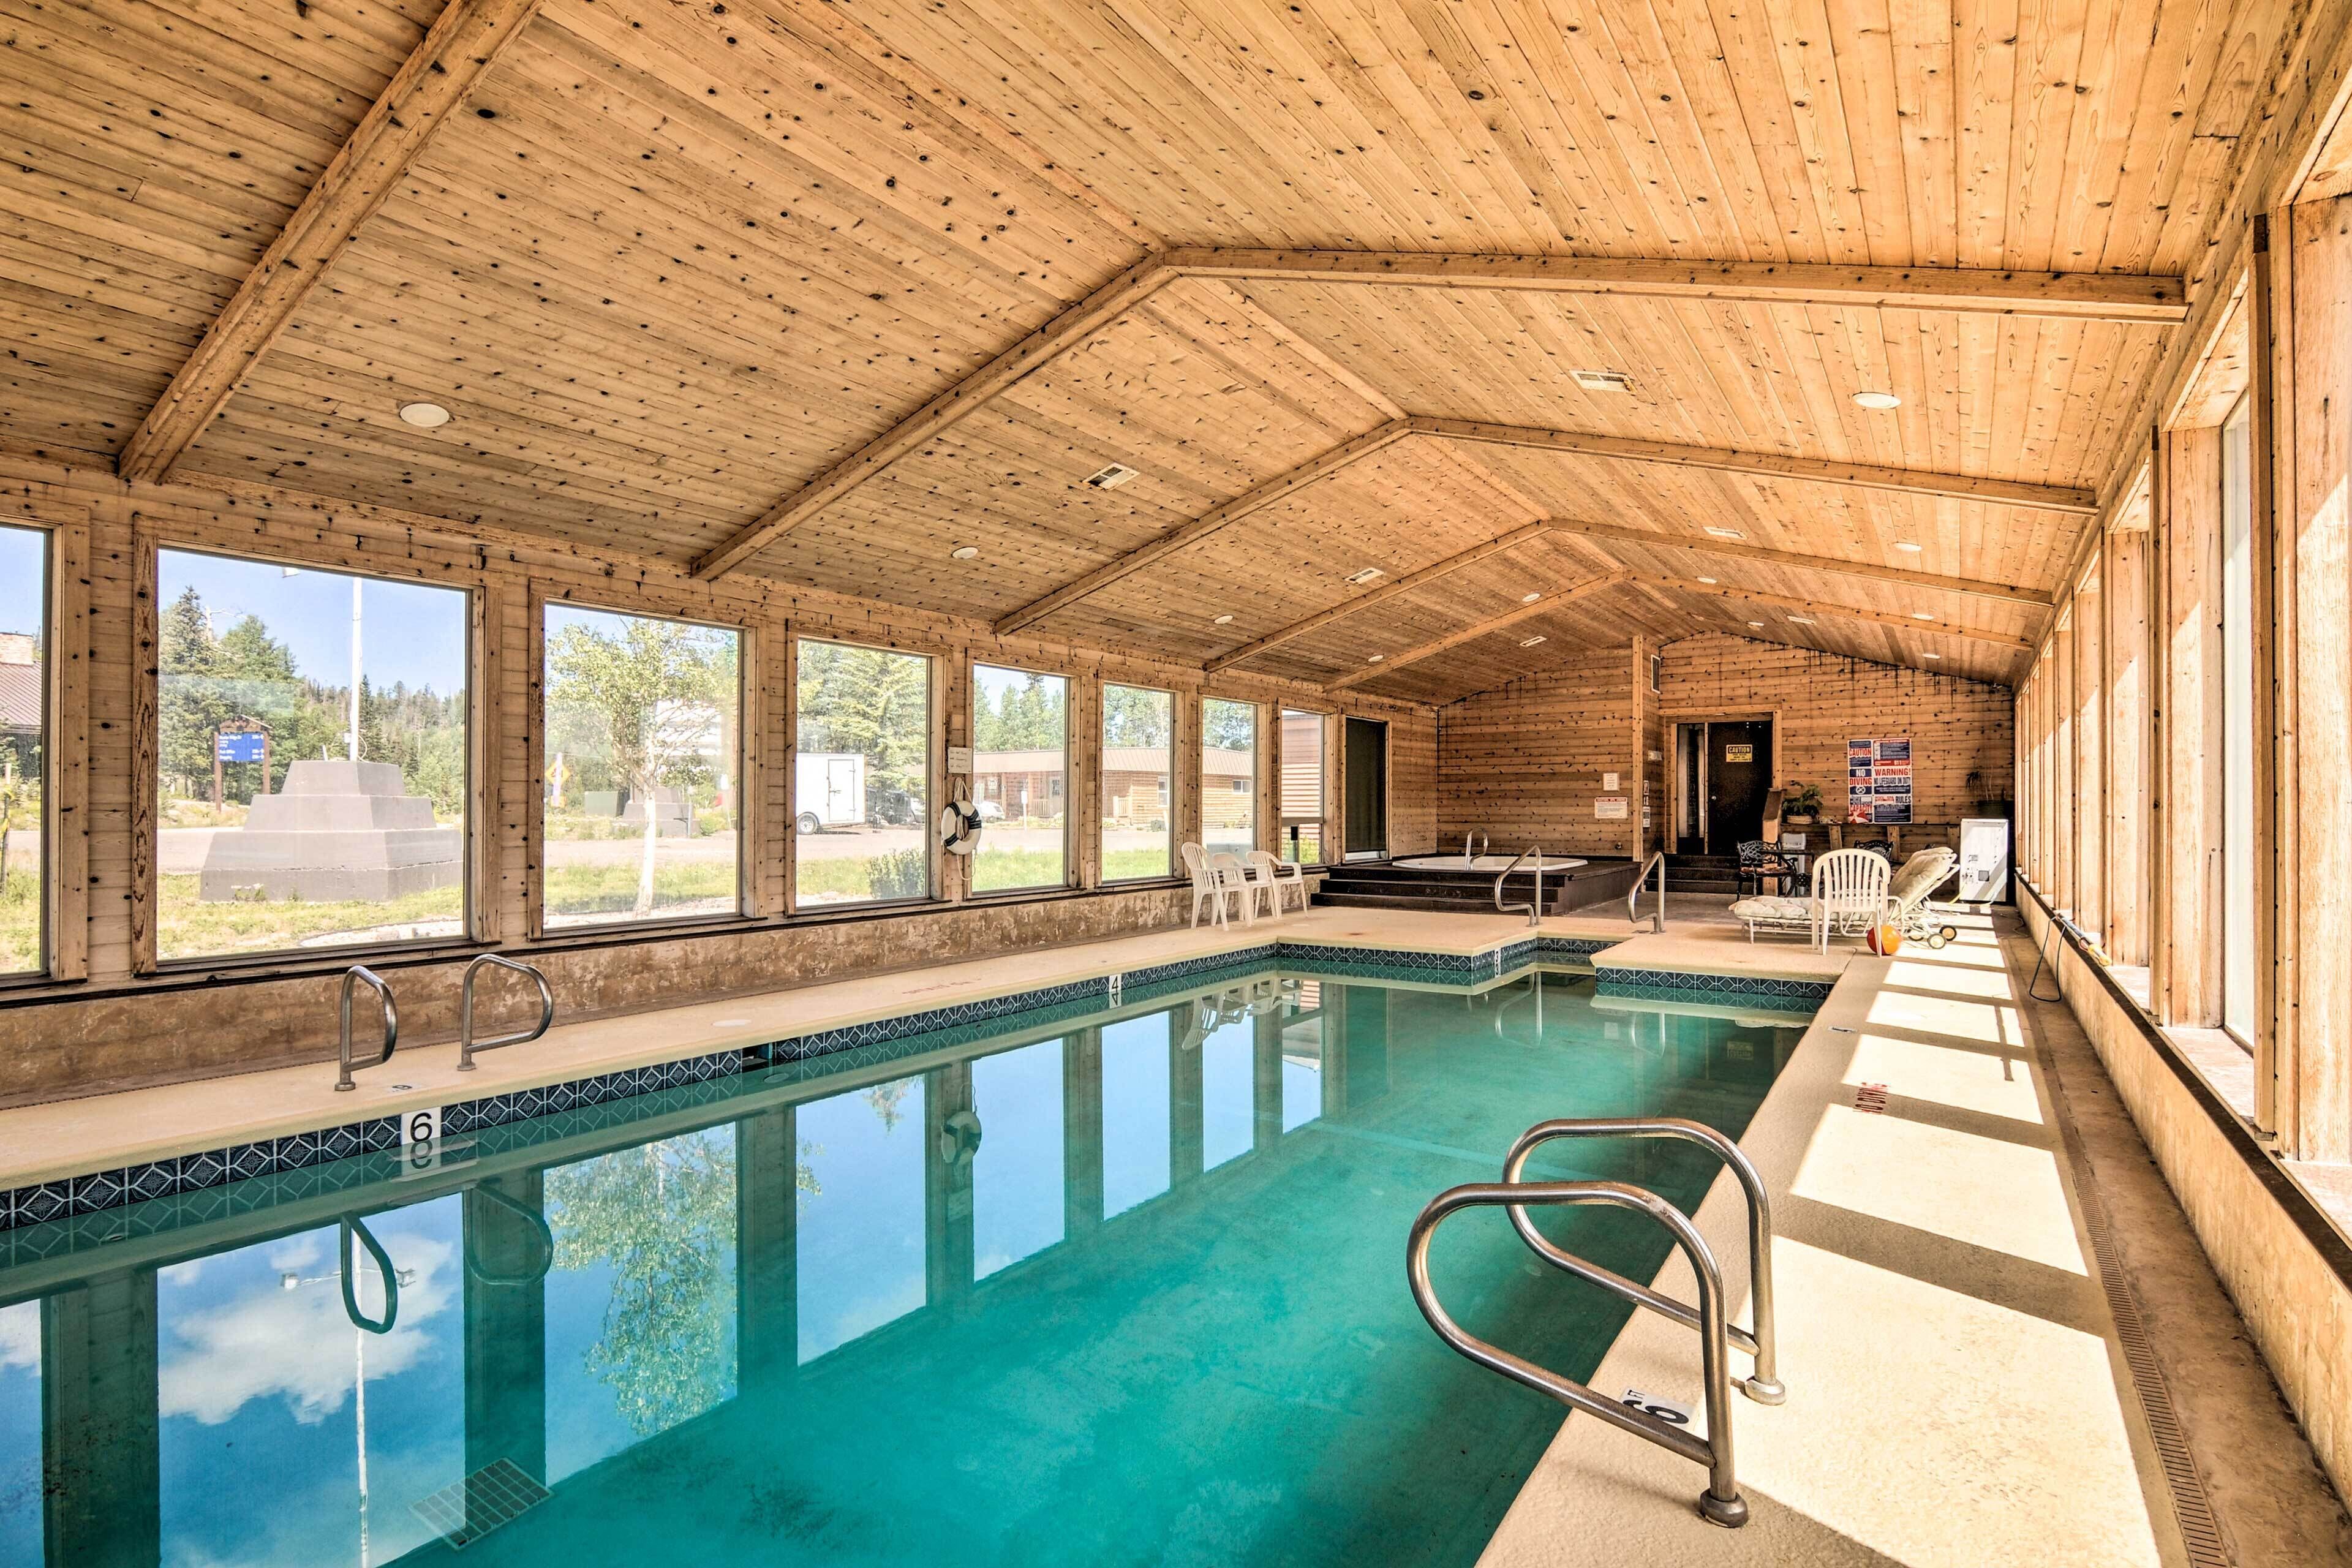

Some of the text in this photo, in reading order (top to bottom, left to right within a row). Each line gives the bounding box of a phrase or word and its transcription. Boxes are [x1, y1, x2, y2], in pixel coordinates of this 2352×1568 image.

[1112, 976, 1119, 991] 4
[410, 1112, 432, 1142] 6
[1623, 1389, 1689, 1424] 6 FT
